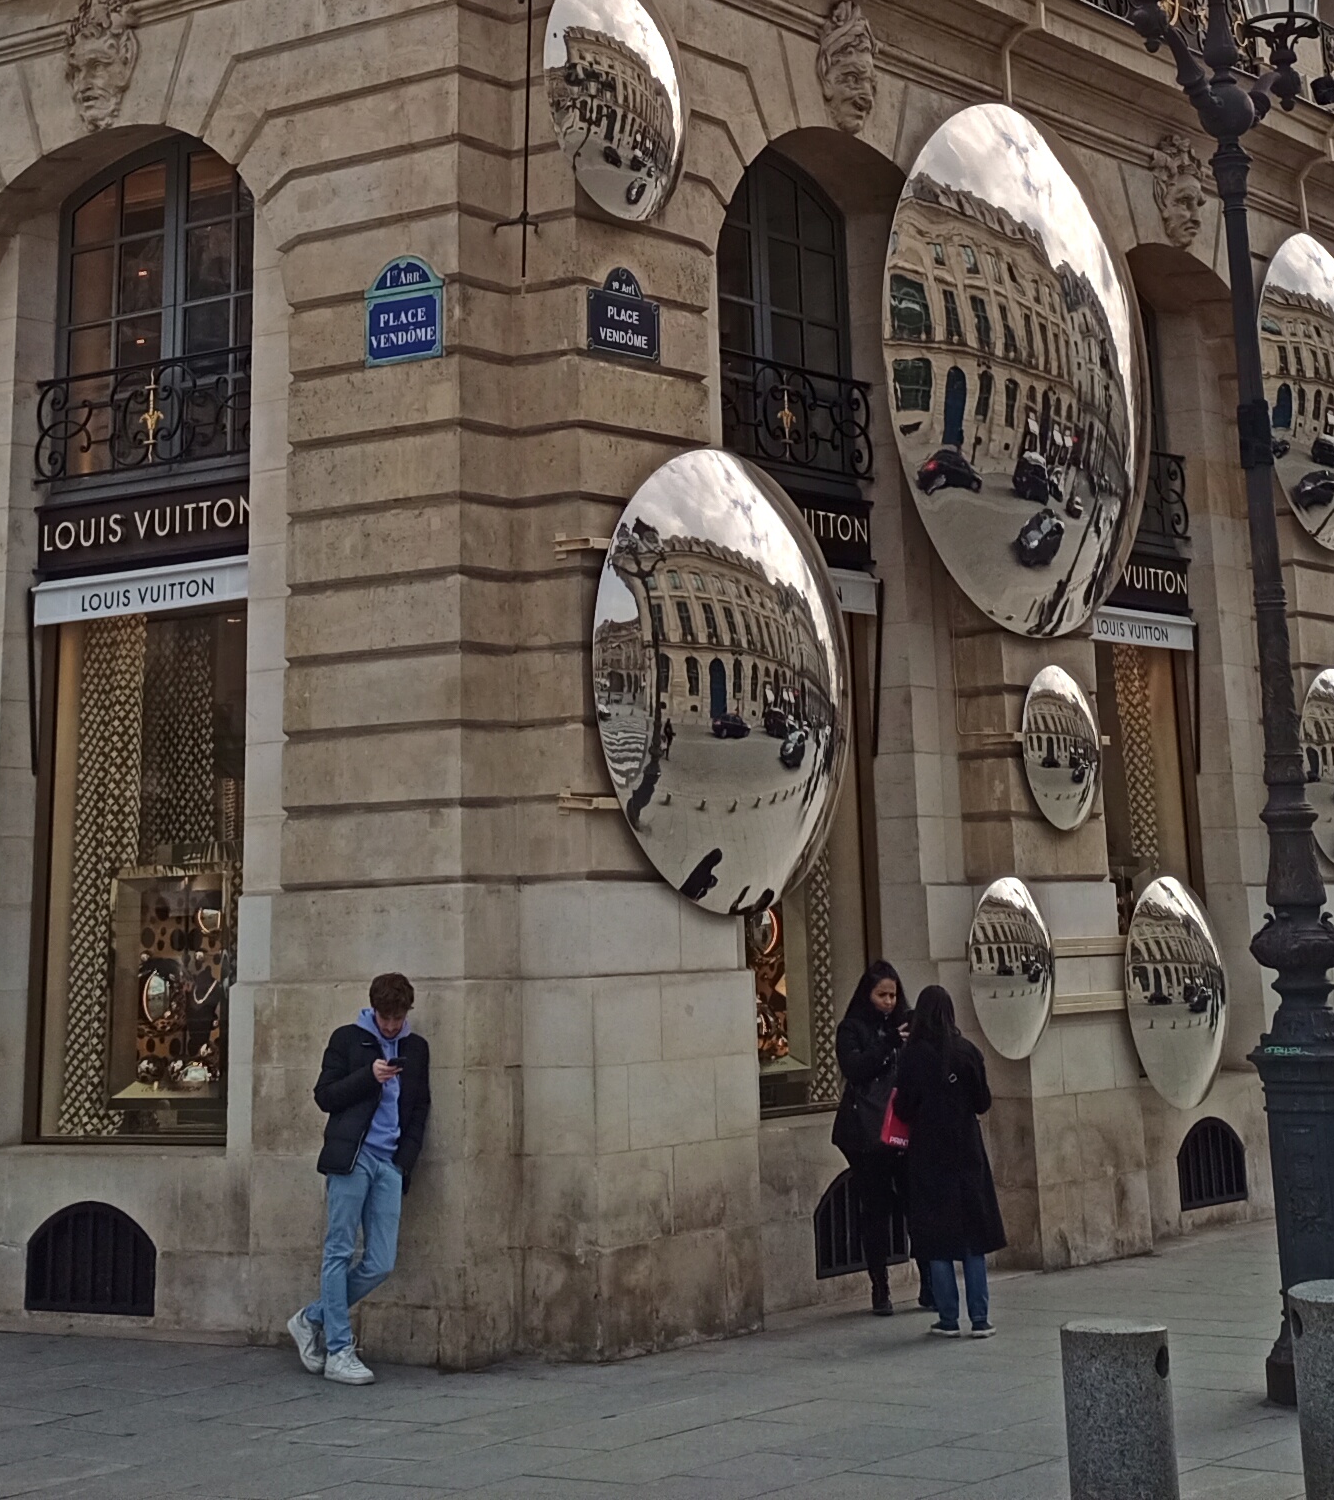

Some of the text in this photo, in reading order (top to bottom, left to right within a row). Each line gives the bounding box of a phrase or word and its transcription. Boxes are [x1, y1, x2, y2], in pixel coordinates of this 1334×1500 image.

[380, 307, 426, 327] PLACE
[607, 305, 639, 325] PLACE
[370, 325, 436, 349] VENDÔME
[599, 326, 649, 349] VENDÔME
[43, 513, 122, 551] LOUIS
[1123, 565, 1187, 595] VUITTON
[81, 577, 214, 612] LOUIS VUITTON
[1097, 619, 1169, 642] LOUIS VUITTON
